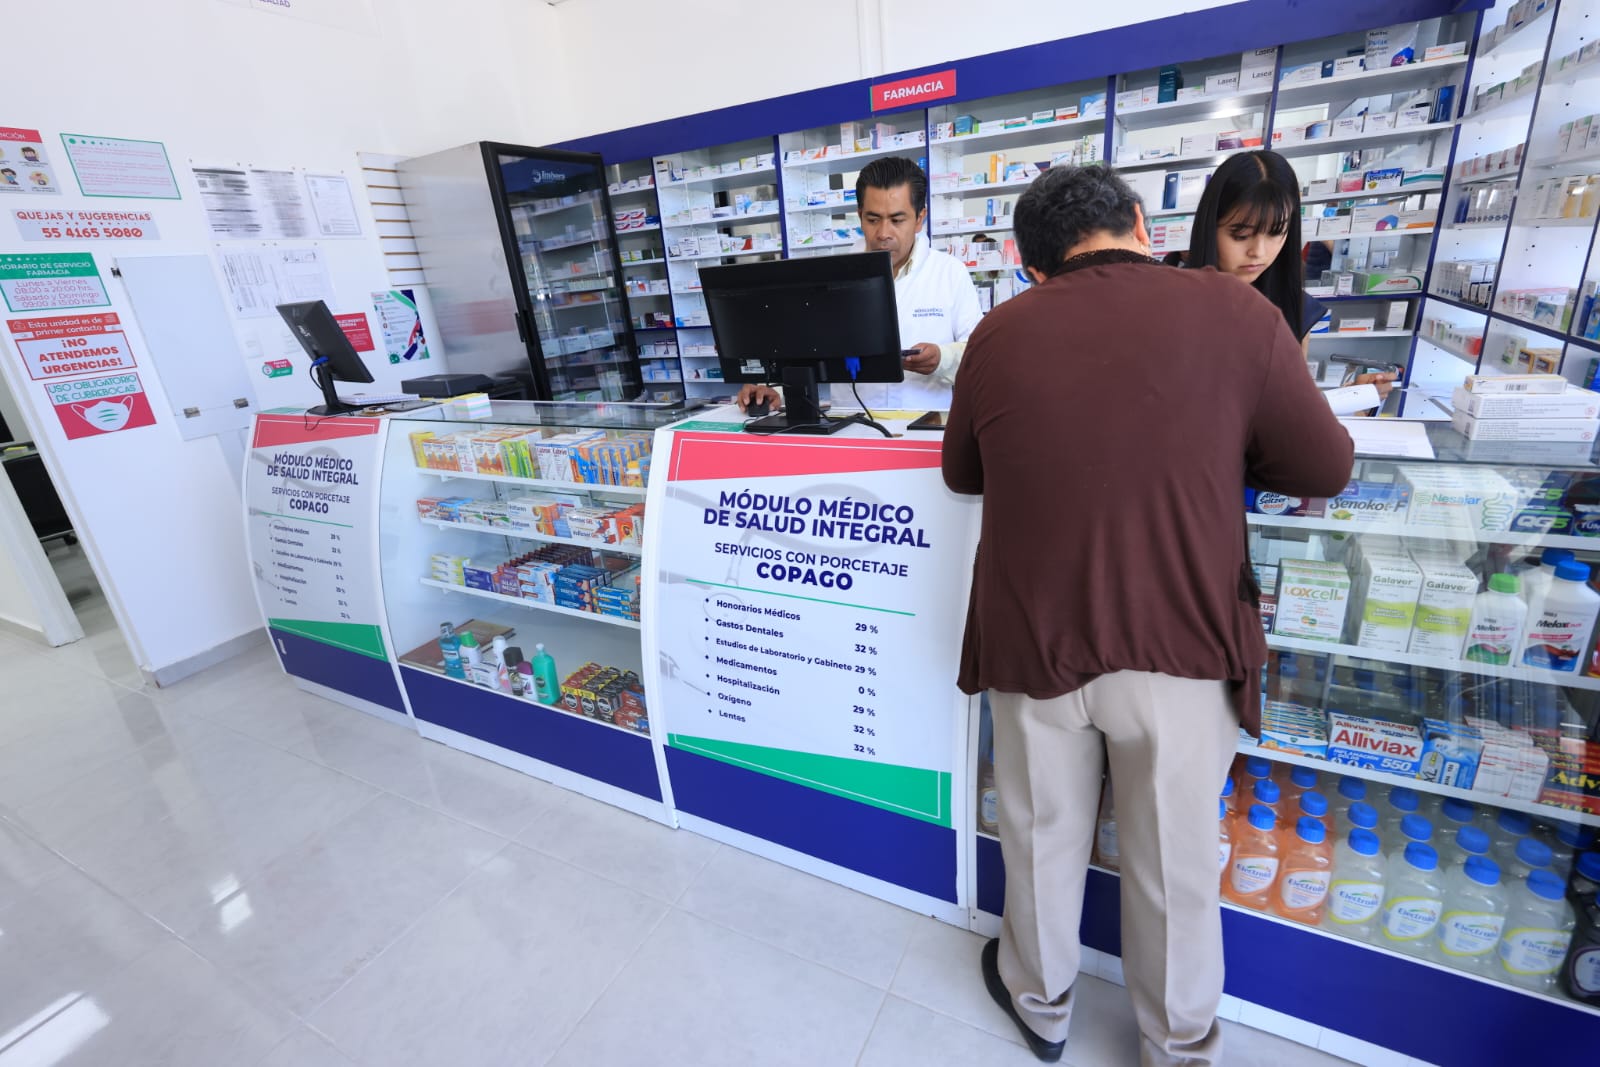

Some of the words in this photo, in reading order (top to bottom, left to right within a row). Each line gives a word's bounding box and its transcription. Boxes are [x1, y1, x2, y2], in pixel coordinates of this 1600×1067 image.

[1218, 77, 1237, 85] Lasea
[1253, 70, 1272, 79] Lasea
[884, 80, 944, 101] FARMACIA
[17, 211, 64, 220] QUEJAS
[66, 212, 74, 220] Y
[78, 212, 151, 221] SUGERENCIAS
[42, 228, 61, 238] 55
[66, 228, 100, 238] 4165
[103, 228, 142, 238] 5080
[36, 329, 64, 337] primer
[66, 325, 103, 333] contacto
[50, 319, 80, 327] unidad
[61, 338, 87, 348] ¡NO
[39, 346, 119, 362] ATENDEMOS
[42, 358, 122, 374] URGENCIAS!
[48, 383, 72, 393] USO
[73, 374, 136, 390] OBLIGATORIO
[56, 393, 70, 403] DE
[72, 385, 136, 400] CUBREBOCAS
[274, 452, 312, 467] MÓDULO
[315, 454, 353, 471] MÉDICO
[267, 465, 279, 476] DE
[280, 467, 310, 479] SALUD
[312, 470, 359, 485] INTEGRAL
[272, 487, 300, 498] SERVICIOS
[301, 491, 314, 499] CON
[315, 492, 350, 503] PORCETAJE
[289, 498, 328, 513] COPAGO
[720, 489, 812, 515] MÓDULO
[818, 497, 914, 524] MÉDICO
[704, 508, 729, 527] DE
[735, 511, 805, 534] SALUD
[812, 519, 930, 548] INTEGRAL
[1517, 515, 1569, 528] QG5
[715, 542, 782, 561] SERVICIOS
[786, 551, 816, 566] CON
[820, 555, 908, 577] PORCETAJE
[756, 562, 853, 591] COPAGO
[1373, 576, 1413, 585] Galaver
[1426, 581, 1467, 591] Galaver
[717, 600, 762, 614] Honorarios
[764, 607, 800, 621] Médicos
[855, 622, 867, 632] 29
[869, 625, 878, 634] %
[1536, 620, 1568, 628] Melox
[716, 619, 744, 630] Gastos
[746, 624, 784, 638] Dentales
[854, 644, 866, 653] 32
[868, 646, 877, 655] %
[716, 638, 747, 650] Estudios
[749, 644, 758, 652] de
[760, 646, 806, 662] Laboratorio
[814, 657, 852, 671] Gabinete
[855, 665, 865, 674] 29
[867, 667, 877, 676] %
[716, 656, 777, 676] Medicamentos
[858, 686, 864, 695] 0
[867, 687, 876, 697] %
[717, 674, 780, 695] Hospitalización
[853, 705, 864, 714] 29
[866, 708, 876, 717] %
[718, 692, 752, 706] Oxígeno
[853, 725, 864, 734] 32
[866, 727, 875, 737] %
[719, 710, 746, 723] Lentes
[854, 744, 865, 753] 32
[867, 746, 876, 756] %
[1336, 720, 1376, 732] Alliviax
[1335, 729, 1416, 758] Alliviax
[1380, 758, 1412, 771] 550
